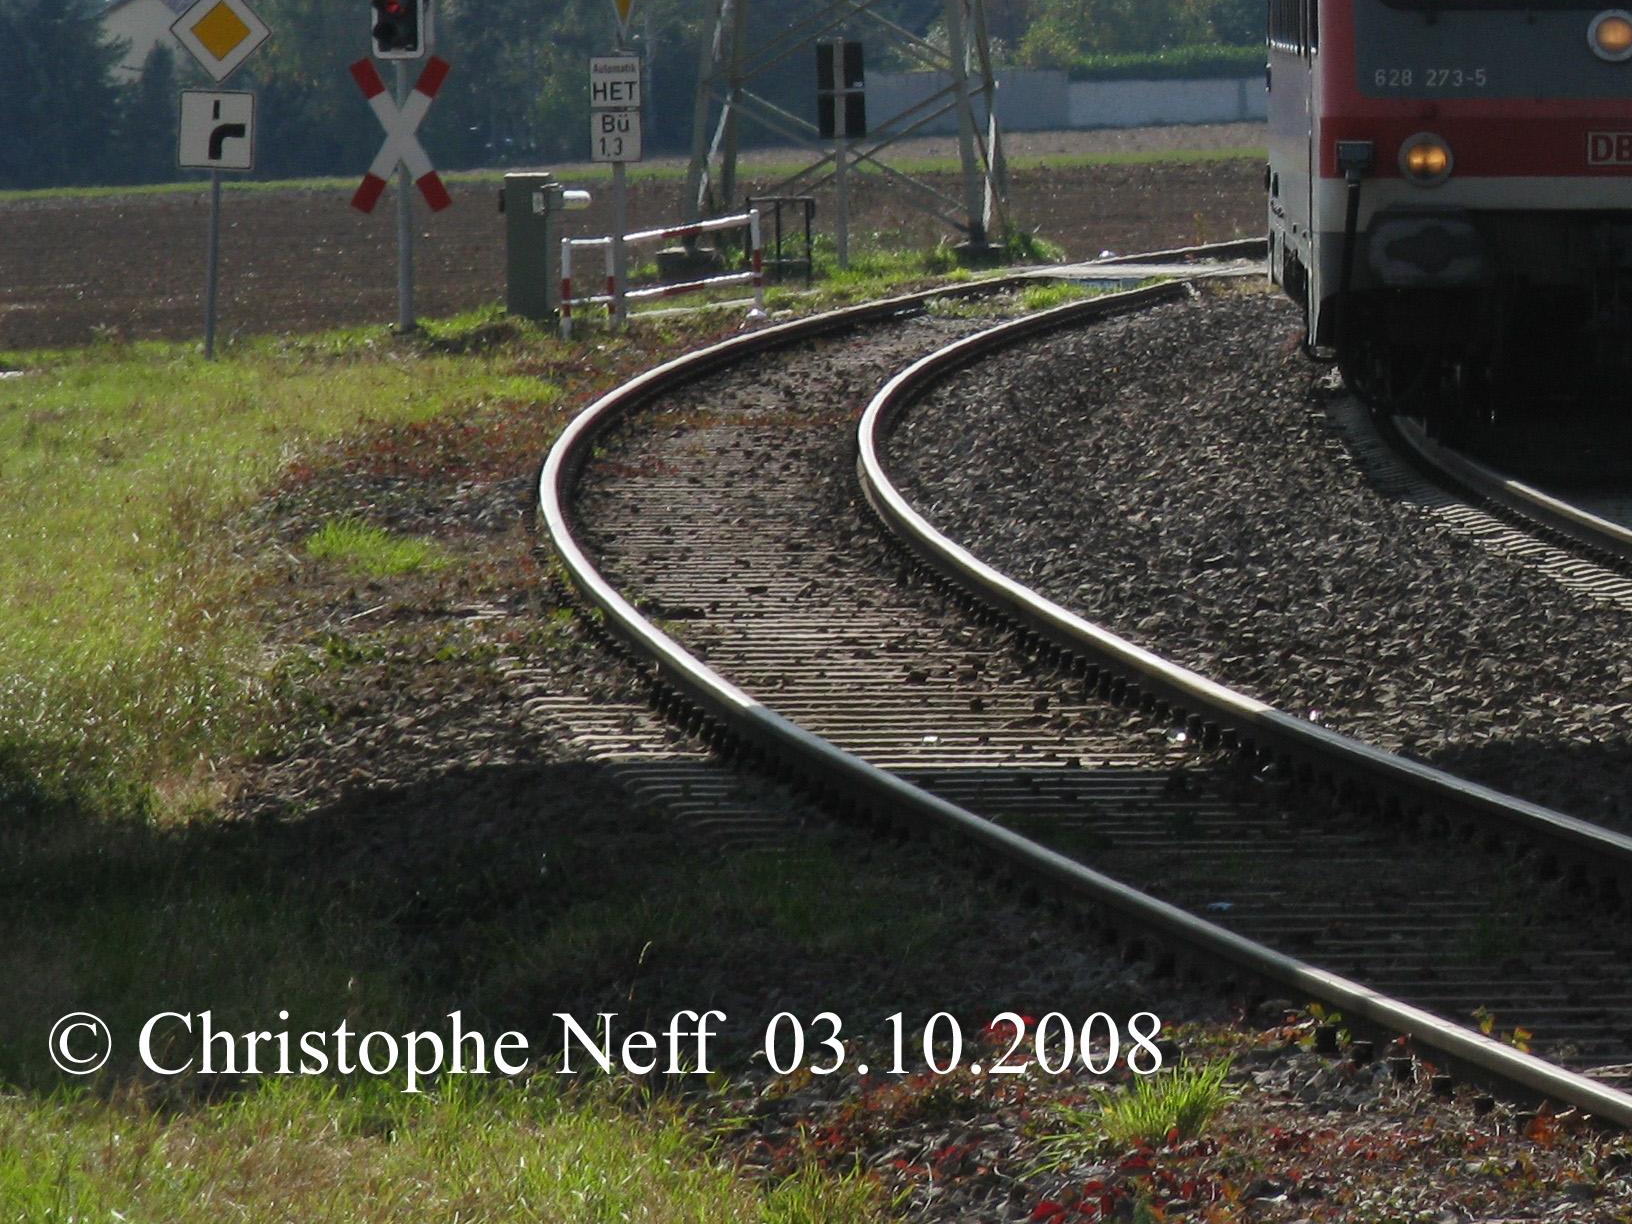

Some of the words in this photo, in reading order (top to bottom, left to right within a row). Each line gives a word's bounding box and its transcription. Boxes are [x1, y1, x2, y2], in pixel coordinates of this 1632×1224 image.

[593, 62, 637, 74] Automatik
[1374, 68, 1413, 87] 628
[1425, 68, 1487, 87] 273-5
[592, 80, 638, 102] HET
